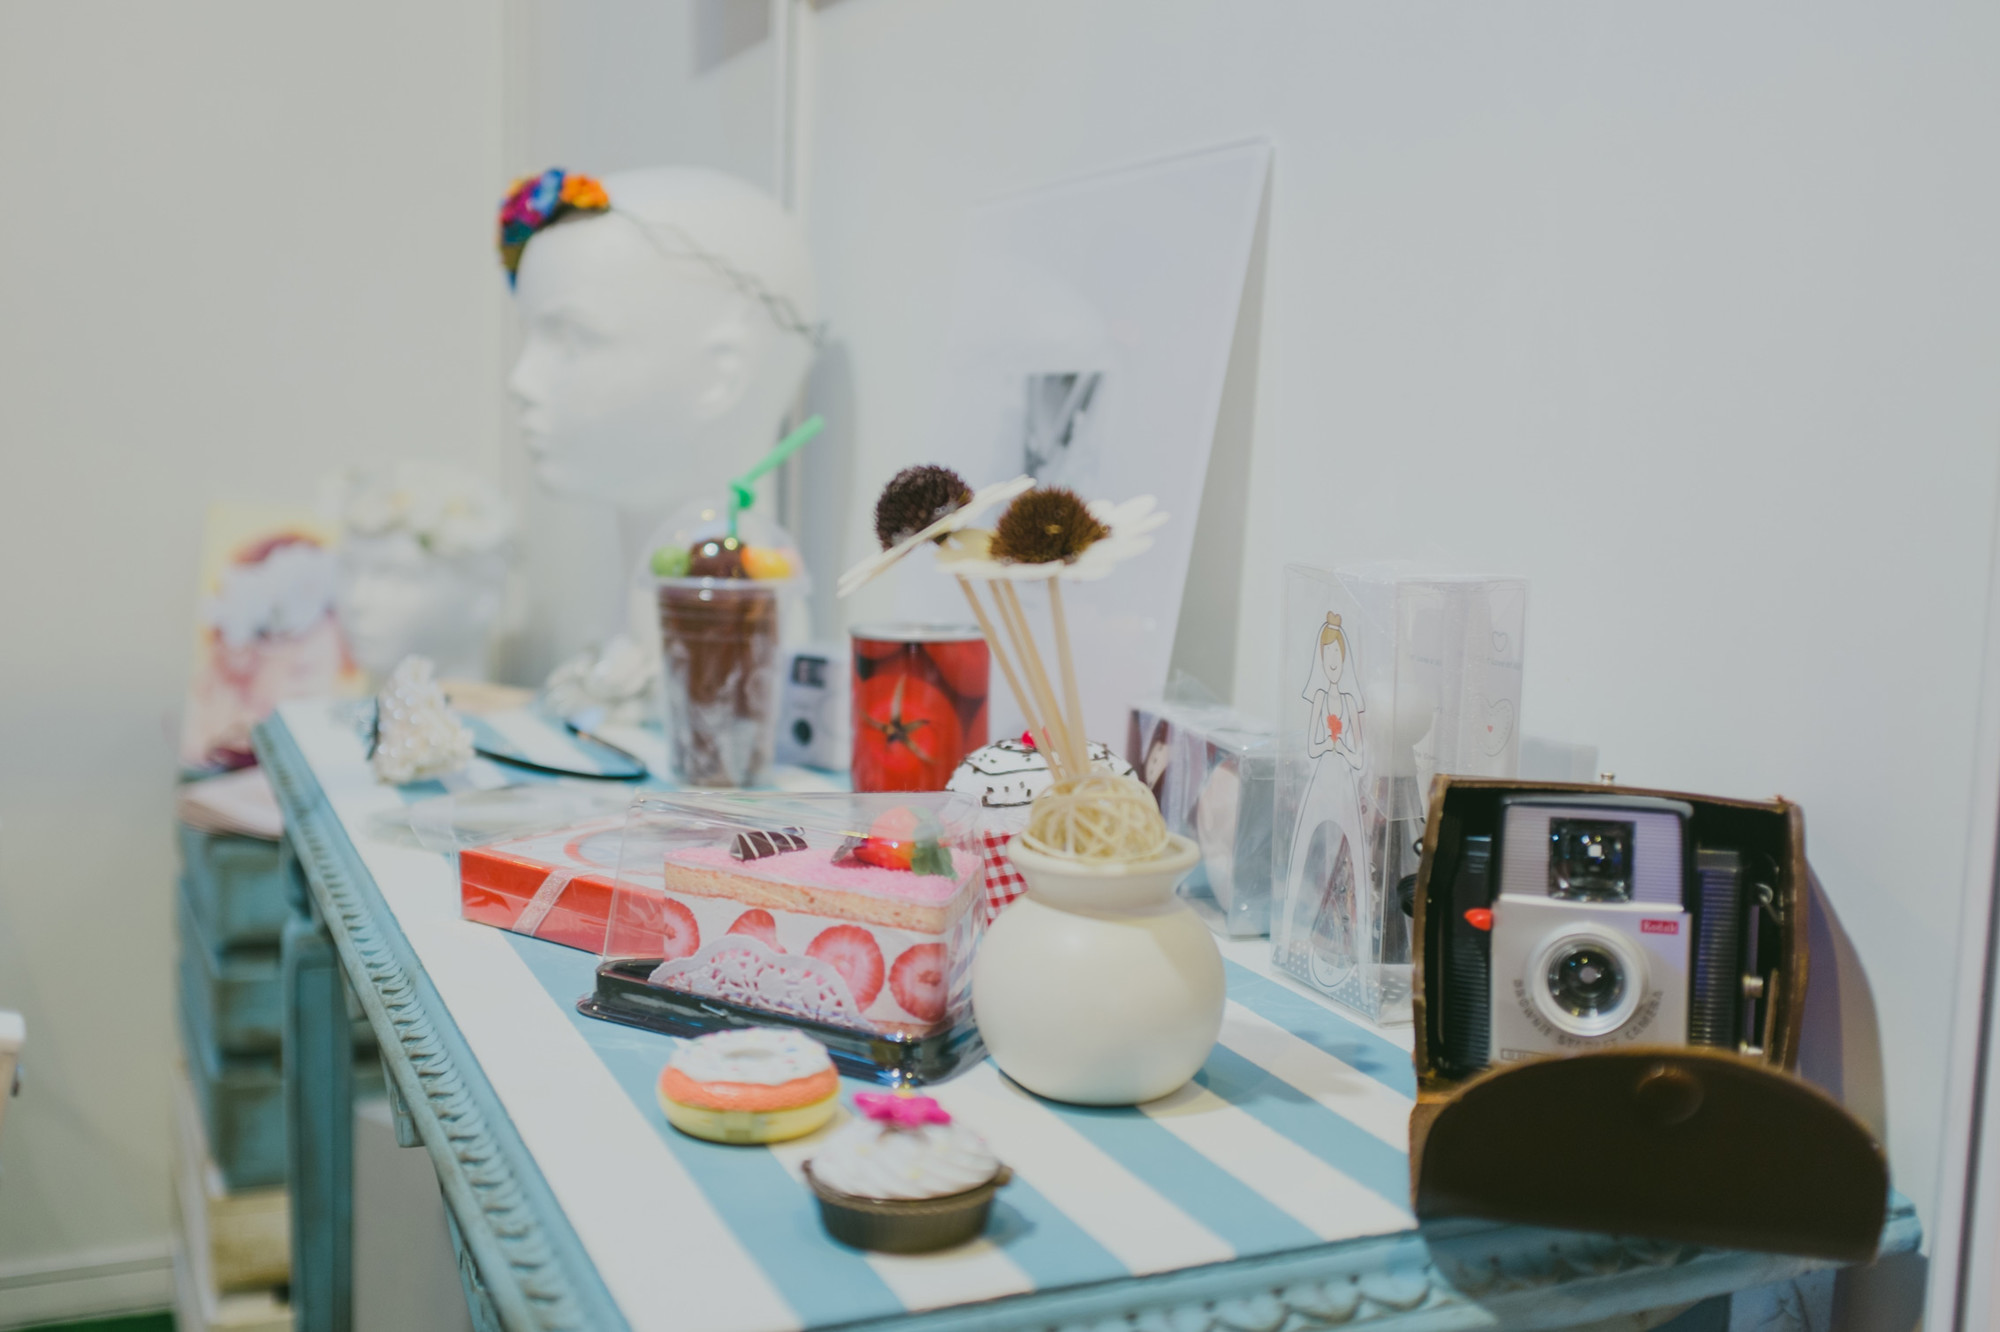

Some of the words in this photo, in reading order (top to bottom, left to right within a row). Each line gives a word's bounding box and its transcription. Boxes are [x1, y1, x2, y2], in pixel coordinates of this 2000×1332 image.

[1643, 920, 1677, 933] Kodak
[1513, 979, 1553, 1037] BROWNIE
[1624, 990, 1664, 1041] CAMERA
